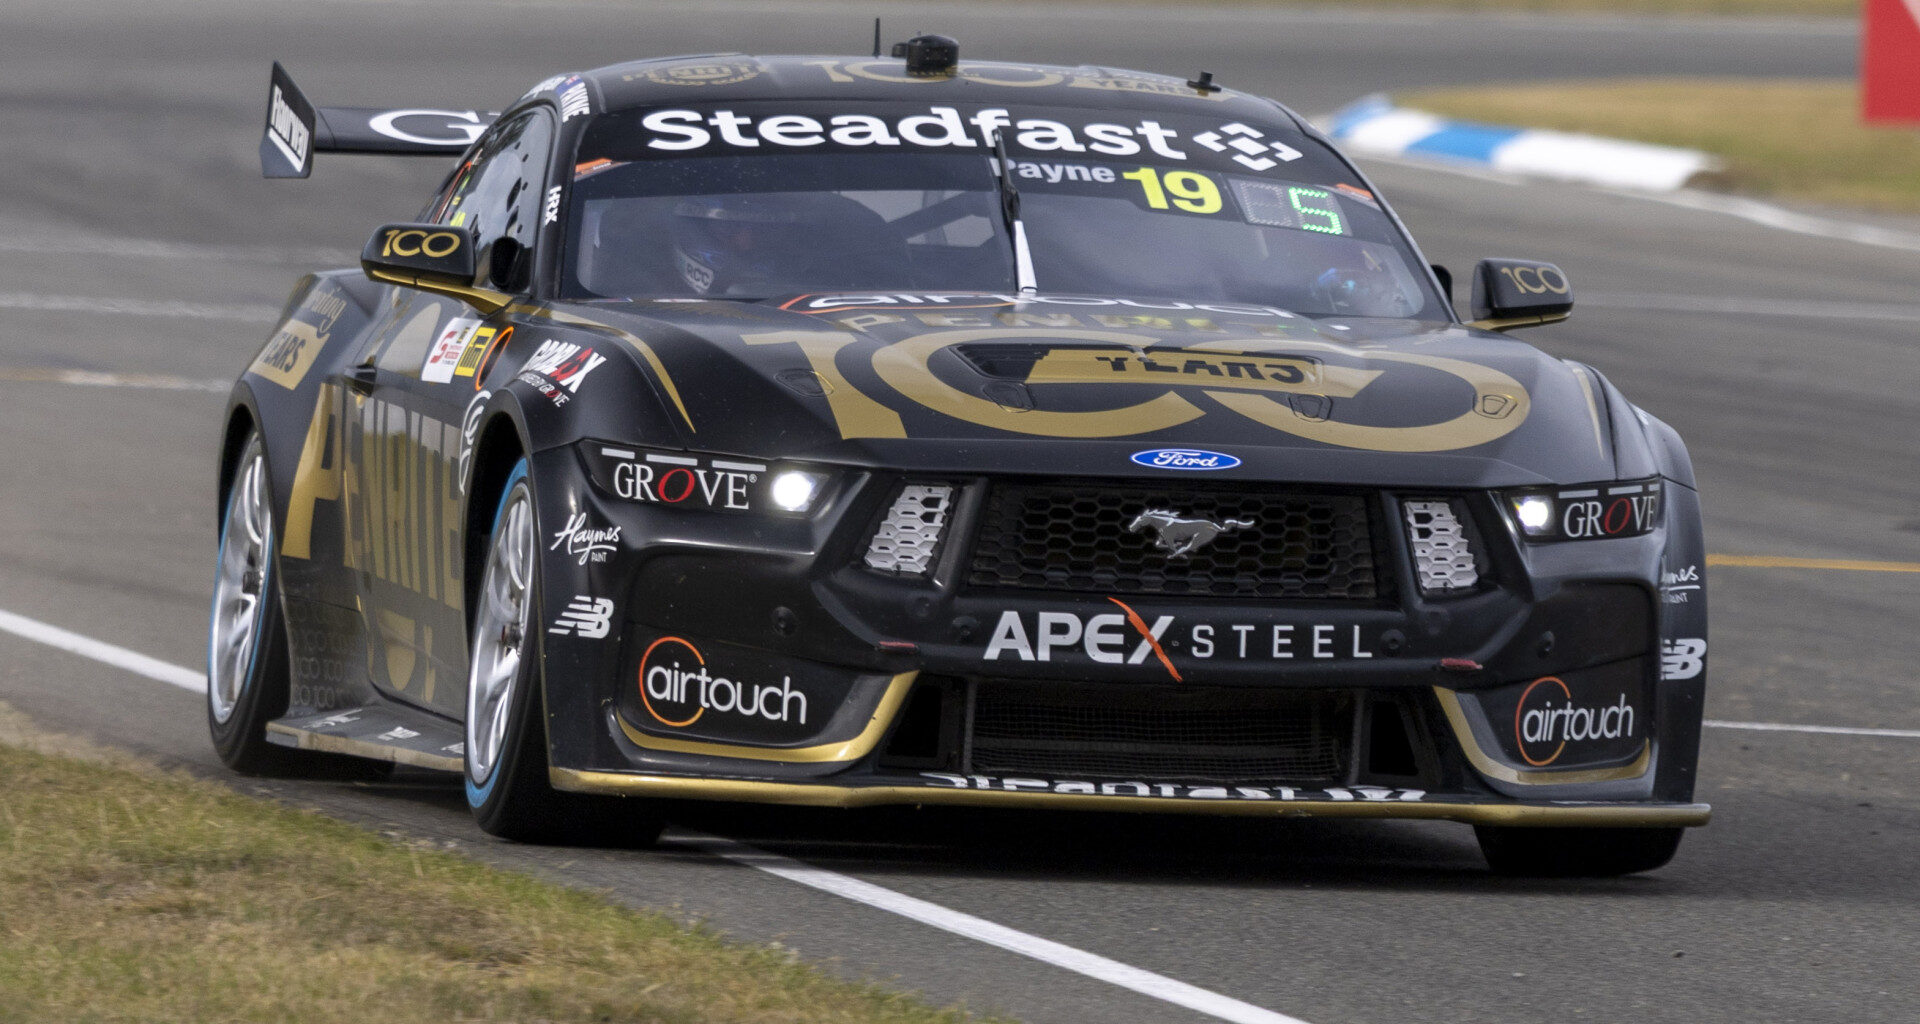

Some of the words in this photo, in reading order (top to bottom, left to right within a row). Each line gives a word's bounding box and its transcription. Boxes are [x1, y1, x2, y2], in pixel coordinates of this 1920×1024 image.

[641, 106, 1188, 161] Steadfast
[1123, 167, 1224, 214] 19
[1152, 450, 1219, 467] Ford
[549, 511, 622, 566] Haymes
[982, 597, 1184, 683] APEX
[1191, 624, 1373, 659] STEEL
[647, 660, 808, 725] airtouch
[1522, 692, 1635, 743] airtouch
